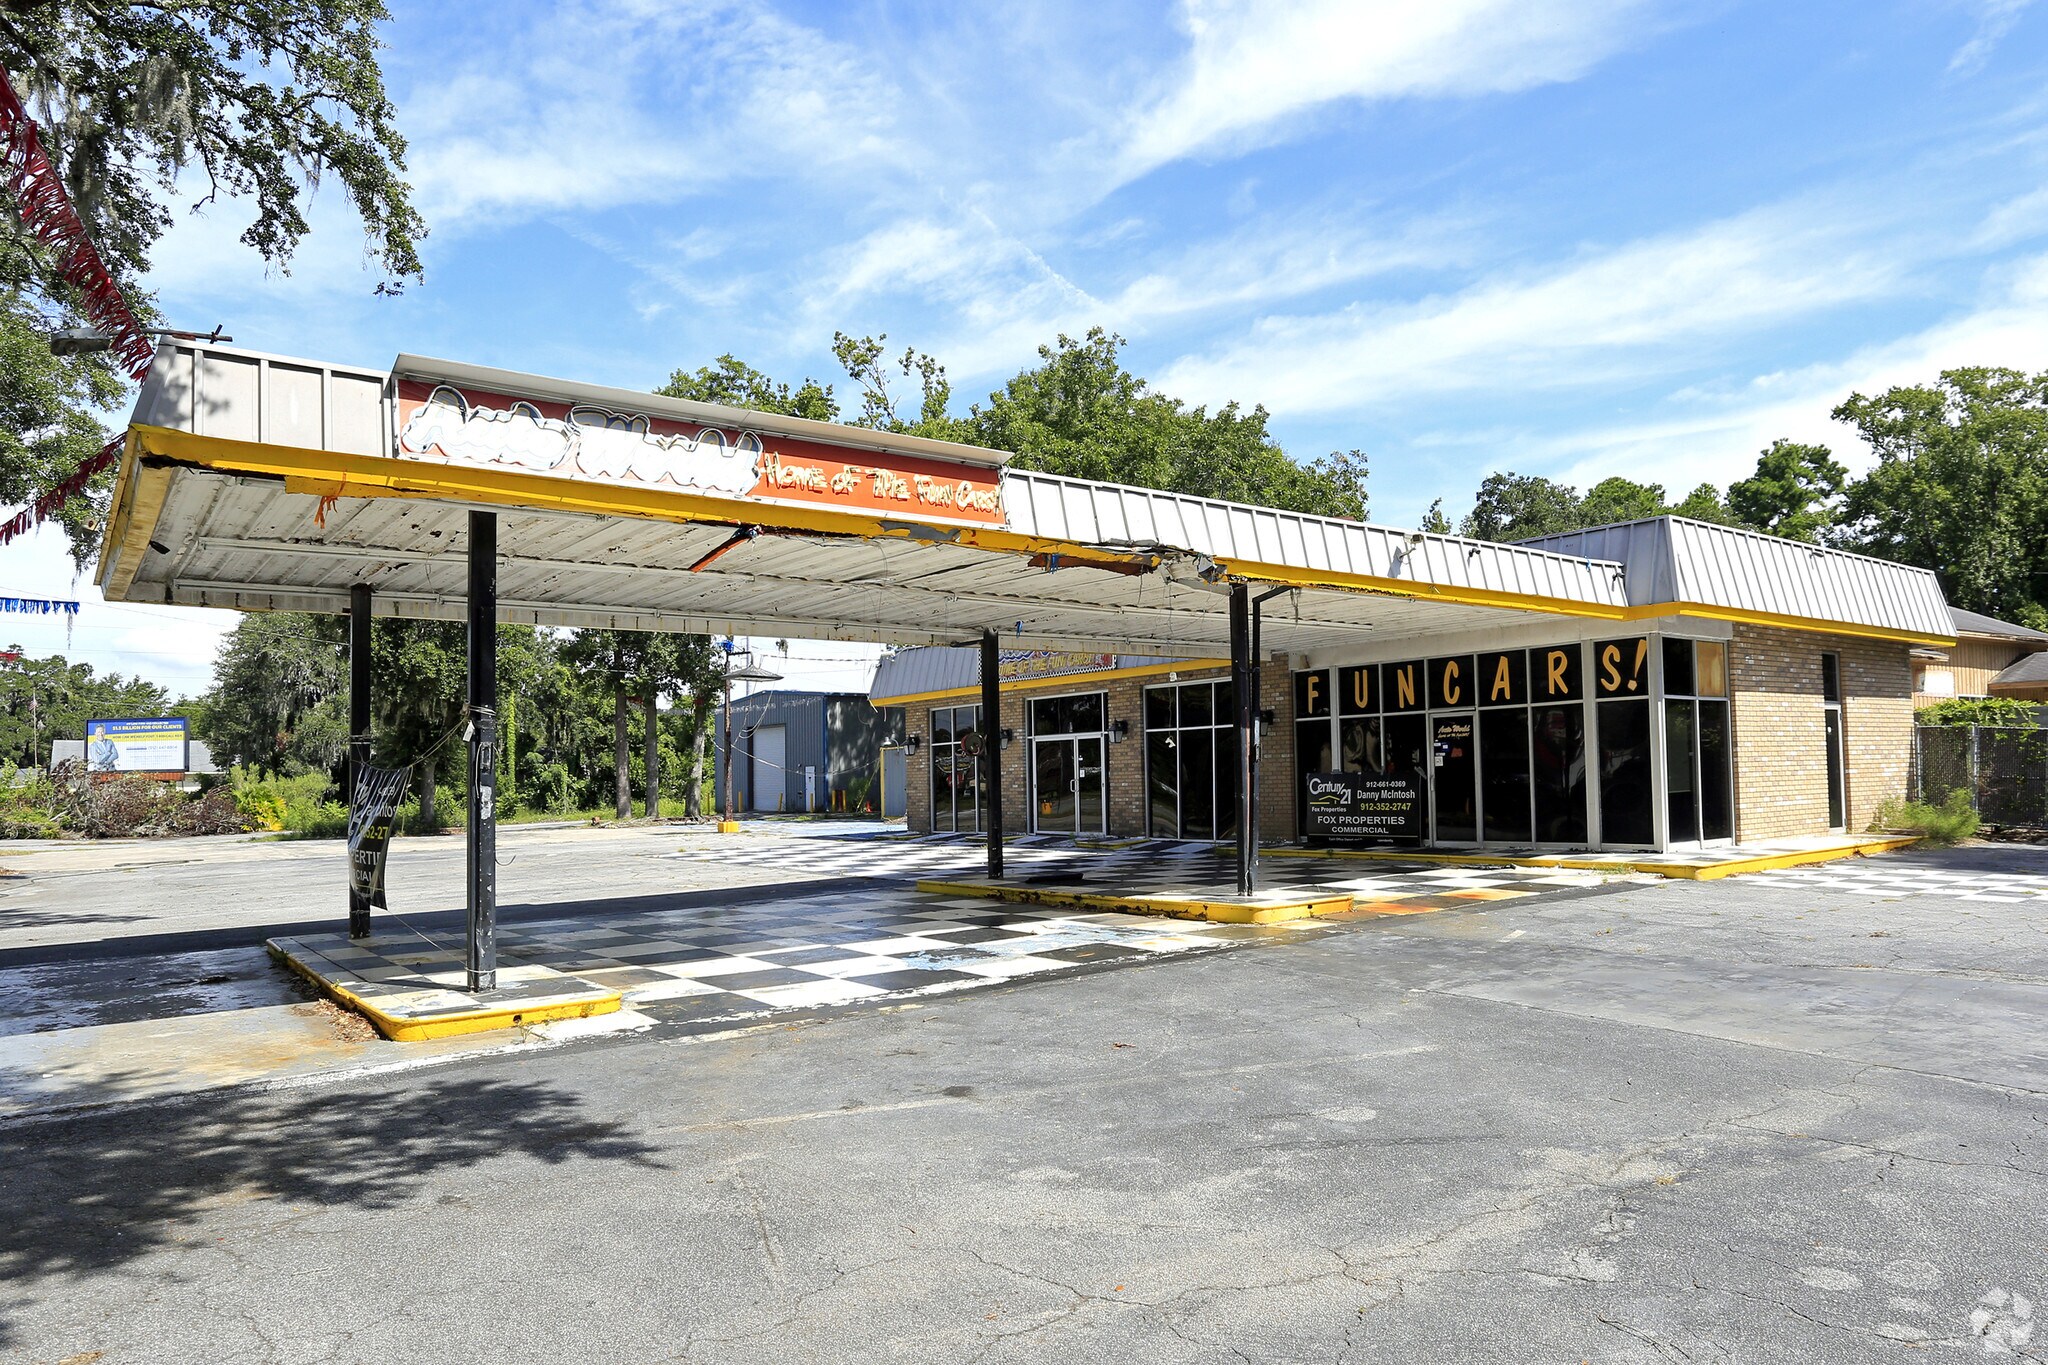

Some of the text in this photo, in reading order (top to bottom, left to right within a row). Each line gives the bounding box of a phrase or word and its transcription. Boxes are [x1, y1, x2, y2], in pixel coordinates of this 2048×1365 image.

[1309, 777, 1345, 795] Century
[1340, 788, 1352, 805] 21
[1357, 789, 1416, 801] Danny McIntosh
[1360, 802, 1412, 811] 912-352-2747
[1317, 816, 1406, 825] FOX PROPERTIES
[1331, 826, 1390, 834] COMMERCIAL
